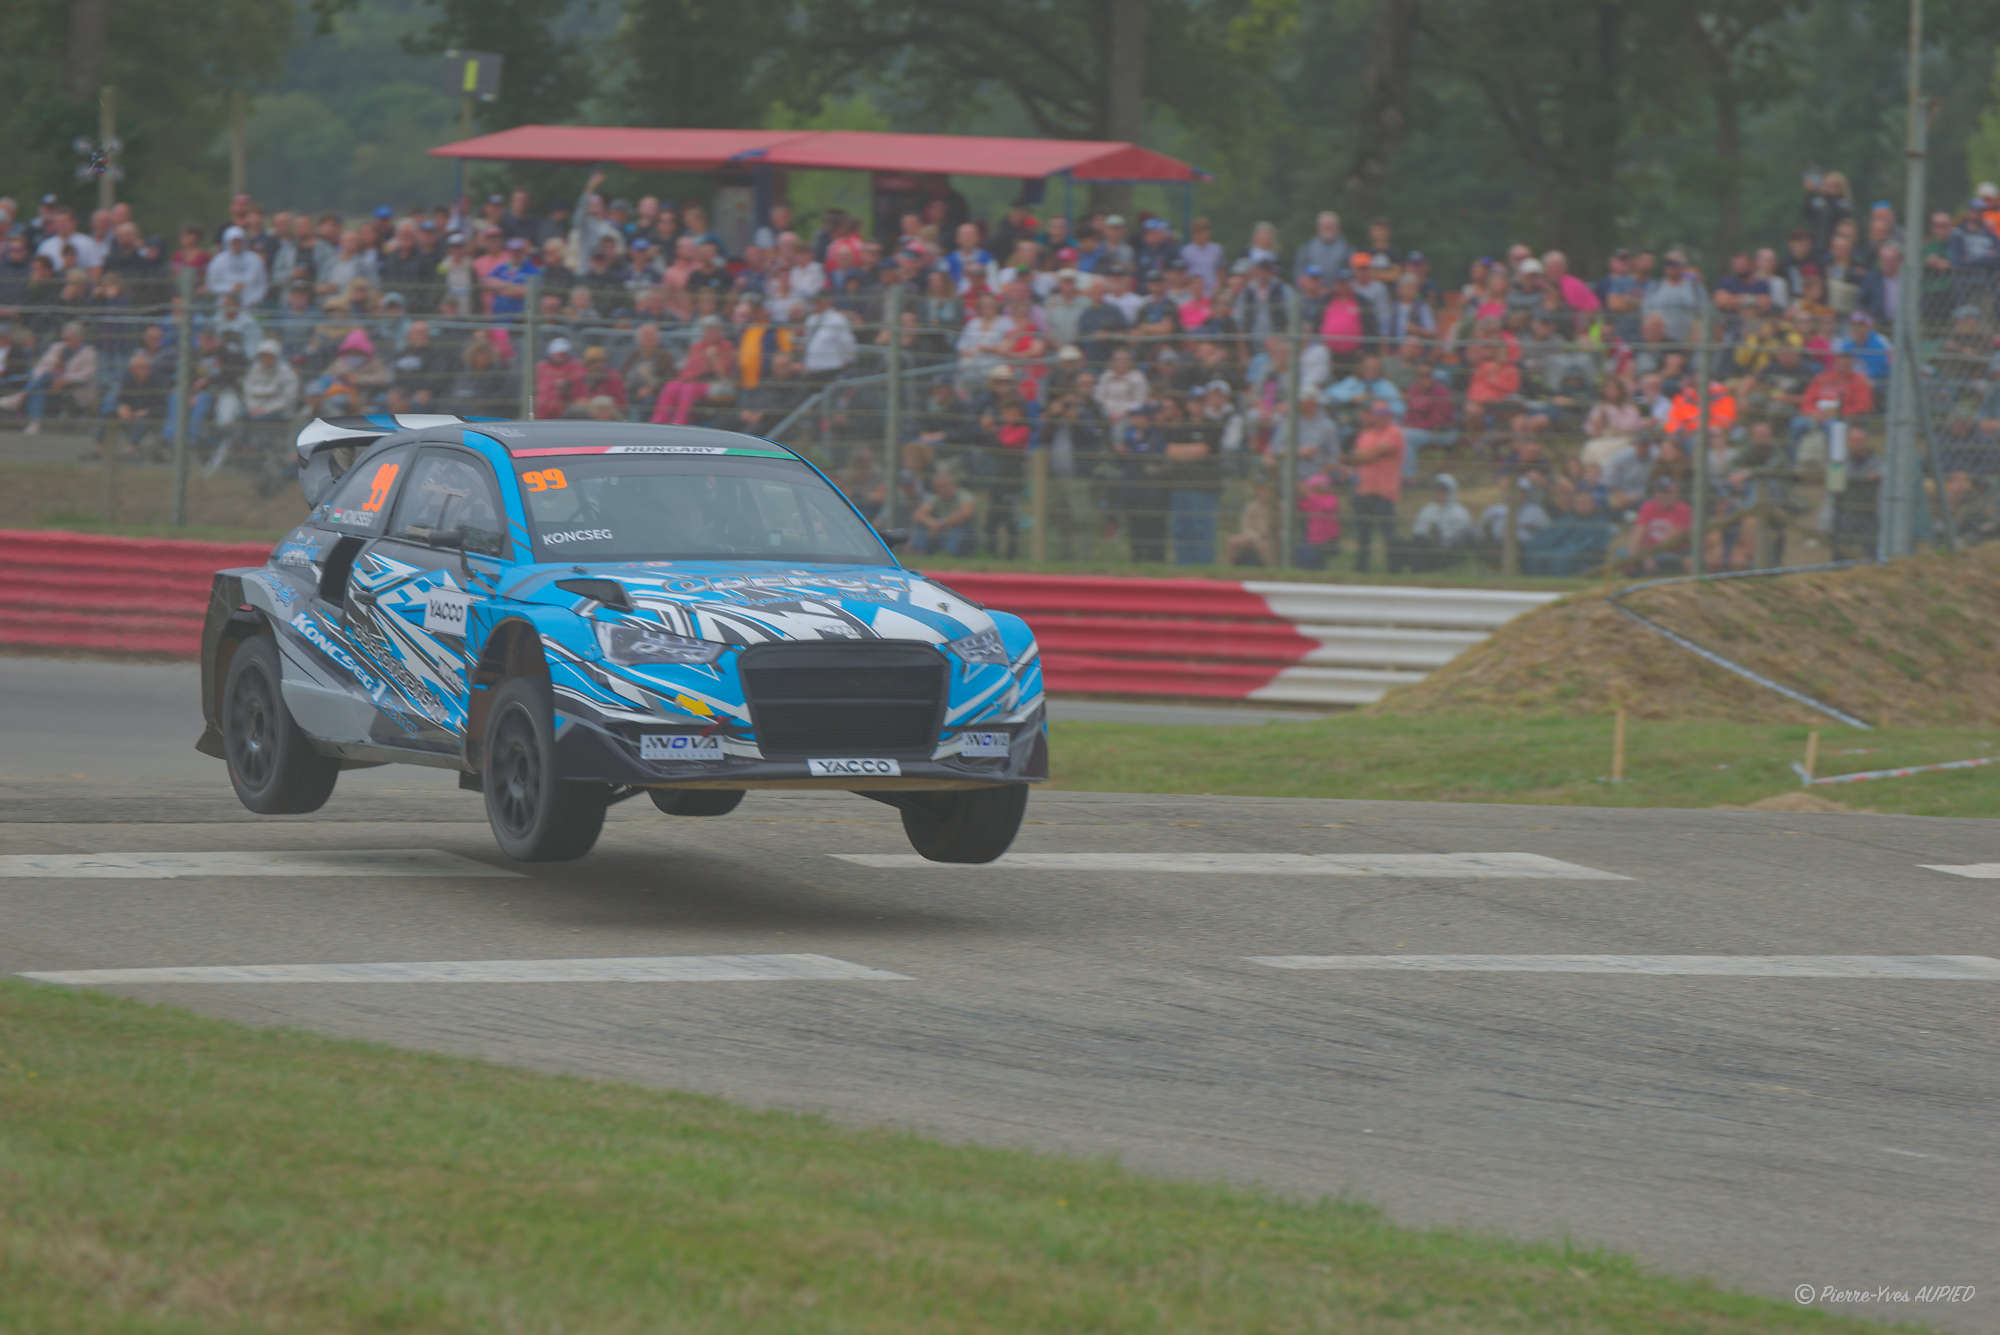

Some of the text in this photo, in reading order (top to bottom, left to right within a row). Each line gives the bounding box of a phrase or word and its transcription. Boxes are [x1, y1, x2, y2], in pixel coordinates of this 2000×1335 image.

[624, 446, 715, 454] HUNGARY
[362, 463, 399, 512] 99
[522, 468, 568, 492] 99
[542, 529, 613, 545] KONCSEG
[430, 599, 463, 622] YACCO
[817, 760, 891, 774] YACCO
